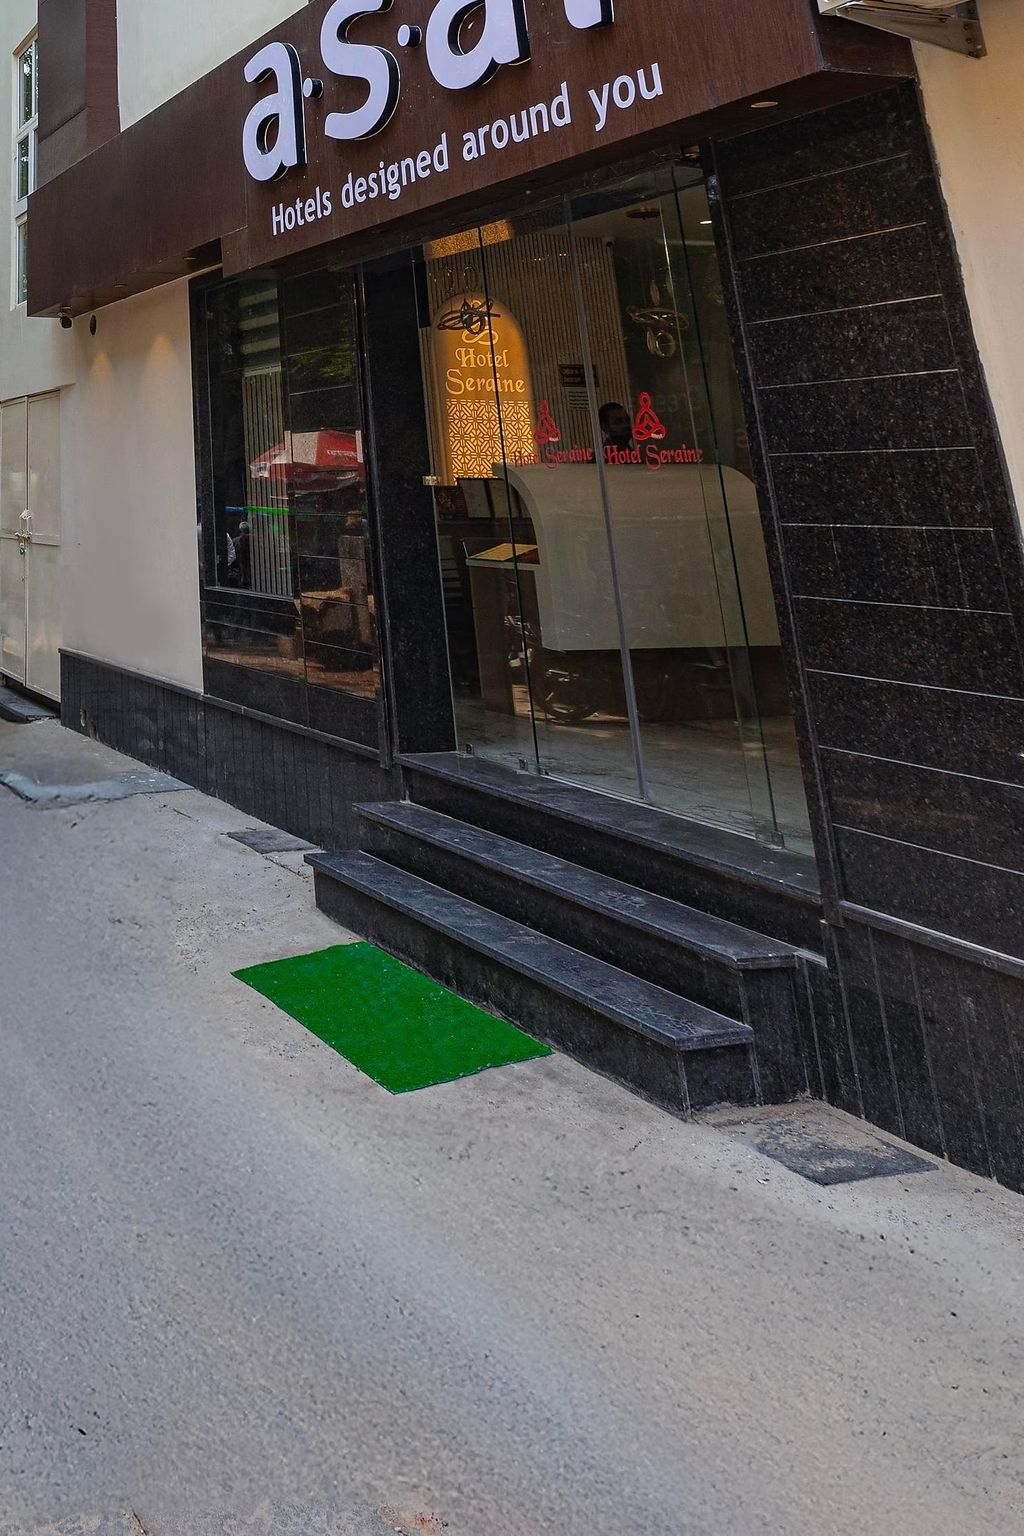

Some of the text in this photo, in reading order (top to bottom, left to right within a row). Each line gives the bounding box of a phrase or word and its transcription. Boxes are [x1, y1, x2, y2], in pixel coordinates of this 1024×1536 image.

[271, 63, 664, 236] Hotels designed around you
[455, 347, 510, 368] Hotel
[445, 368, 526, 395] Seraine
[544, 444, 593, 470] Seraine
[604, 444, 642, 465] Hotel
